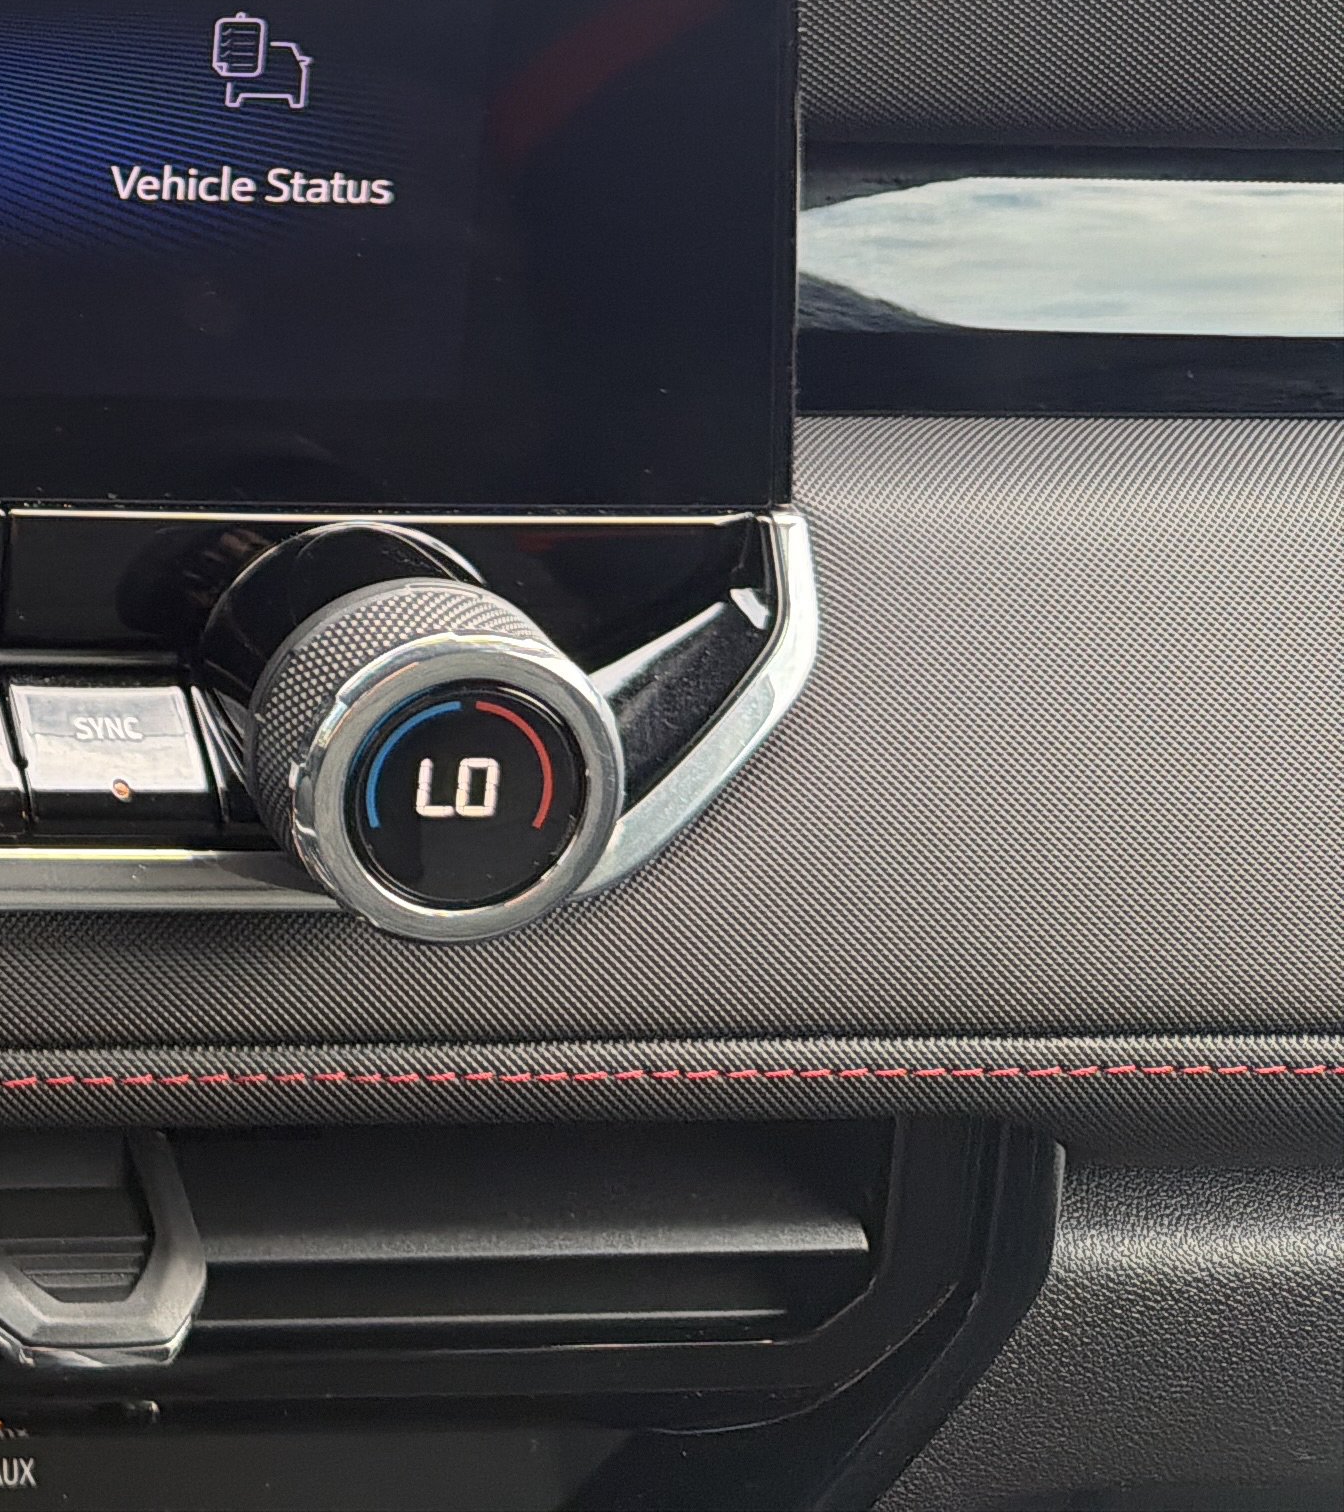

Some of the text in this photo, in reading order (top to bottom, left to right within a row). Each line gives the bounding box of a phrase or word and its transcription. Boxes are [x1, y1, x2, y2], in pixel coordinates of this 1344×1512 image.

[110, 164, 393, 205] Vehicle Status
[73, 716, 144, 742] SYNC
[415, 757, 500, 818] LO
